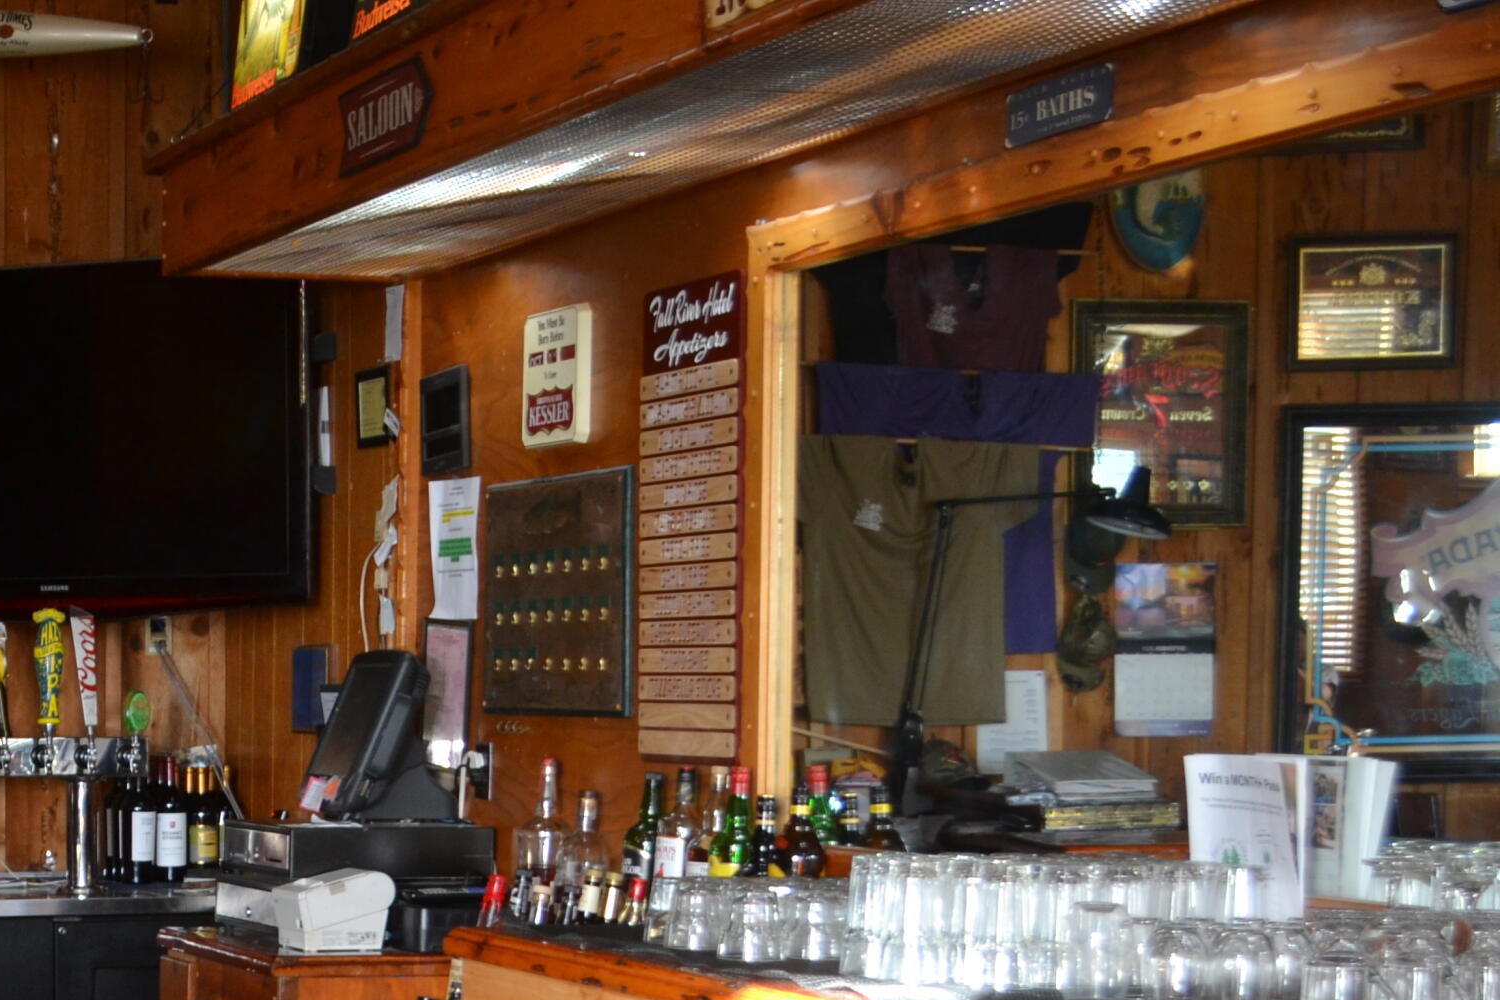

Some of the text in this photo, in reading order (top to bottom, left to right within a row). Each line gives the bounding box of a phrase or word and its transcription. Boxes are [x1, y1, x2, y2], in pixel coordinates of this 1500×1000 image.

[4, 10, 33, 31] TIMES
[347, 81, 414, 151] SALOON
[1035, 85, 1096, 121] BATHS
[649, 281, 736, 333] Fall River Hotel
[653, 328, 728, 368] Appetizers
[528, 400, 569, 428] KESSLER
[39, 584, 69, 592] SAMSUNG
[76, 616, 97, 694] Coors
[1198, 771, 1223, 785] Win
[1224, 777, 1230, 785] a
